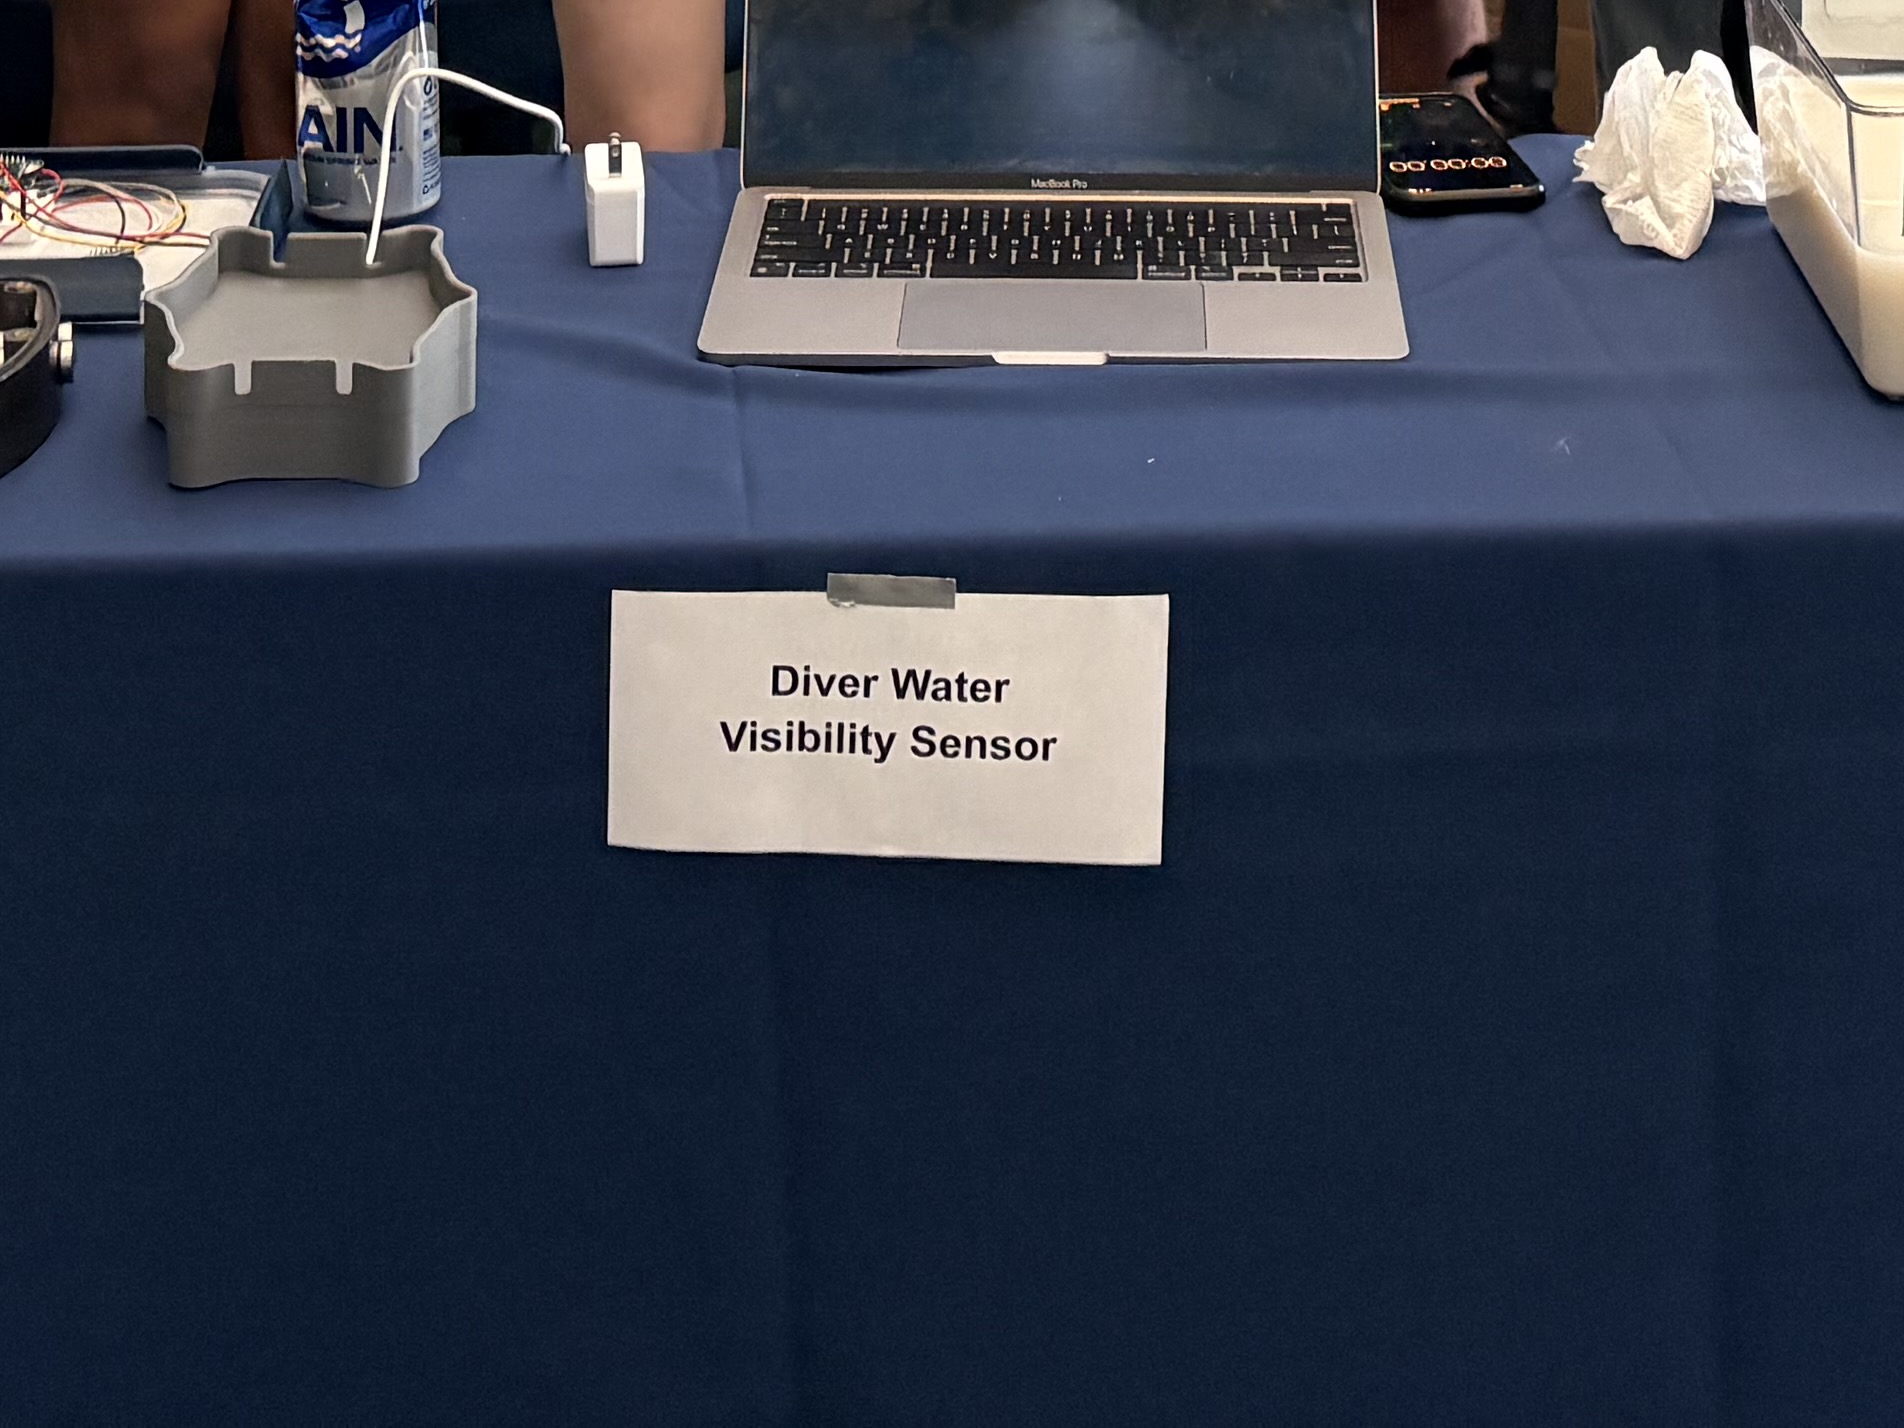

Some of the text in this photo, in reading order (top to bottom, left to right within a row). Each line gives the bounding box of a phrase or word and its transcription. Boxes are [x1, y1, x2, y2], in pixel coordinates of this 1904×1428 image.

[1031, 178, 1088, 189] MacBook Pro
[771, 663, 1010, 705] Diver Water
[719, 719, 1058, 764] Visibility Sensor
